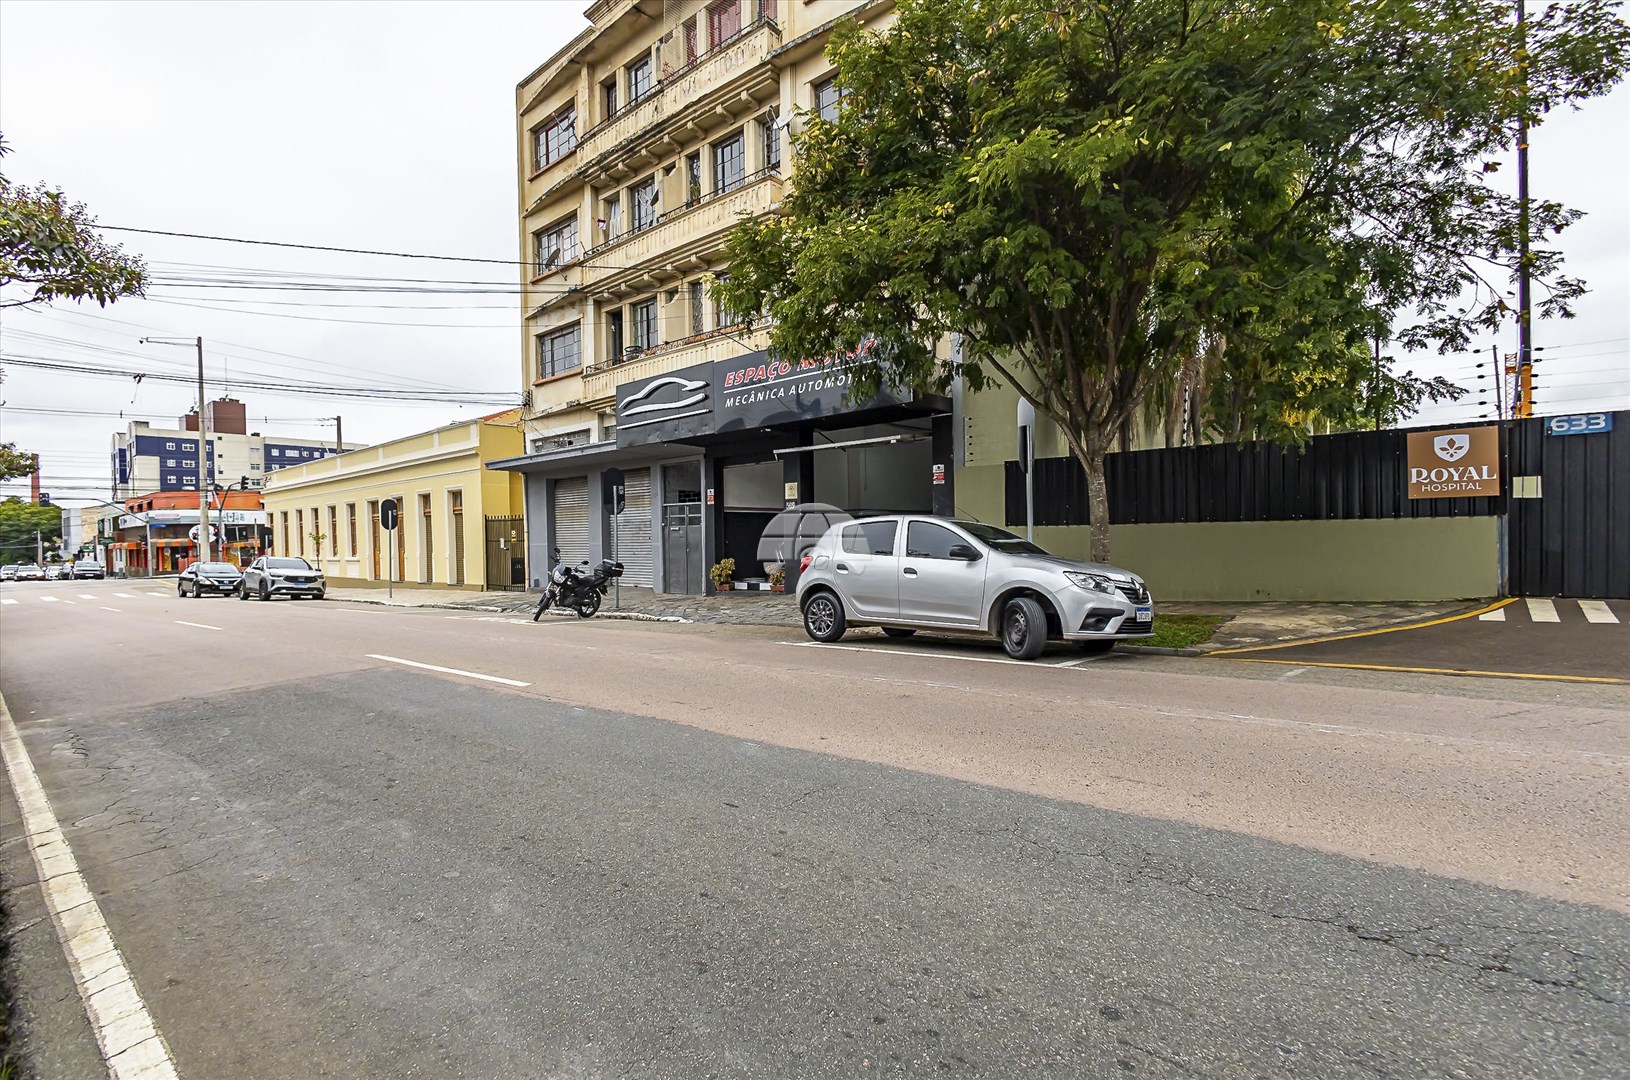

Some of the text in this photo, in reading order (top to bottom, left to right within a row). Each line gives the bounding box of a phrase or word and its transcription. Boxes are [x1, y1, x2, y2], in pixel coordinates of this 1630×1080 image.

[724, 359, 792, 388] ESPAÇO
[724, 388, 785, 408] MECÂNICA
[1550, 413, 1606, 432] 633
[1410, 465, 1497, 484] ROYAL
[1421, 482, 1482, 493] HOSPITAL
